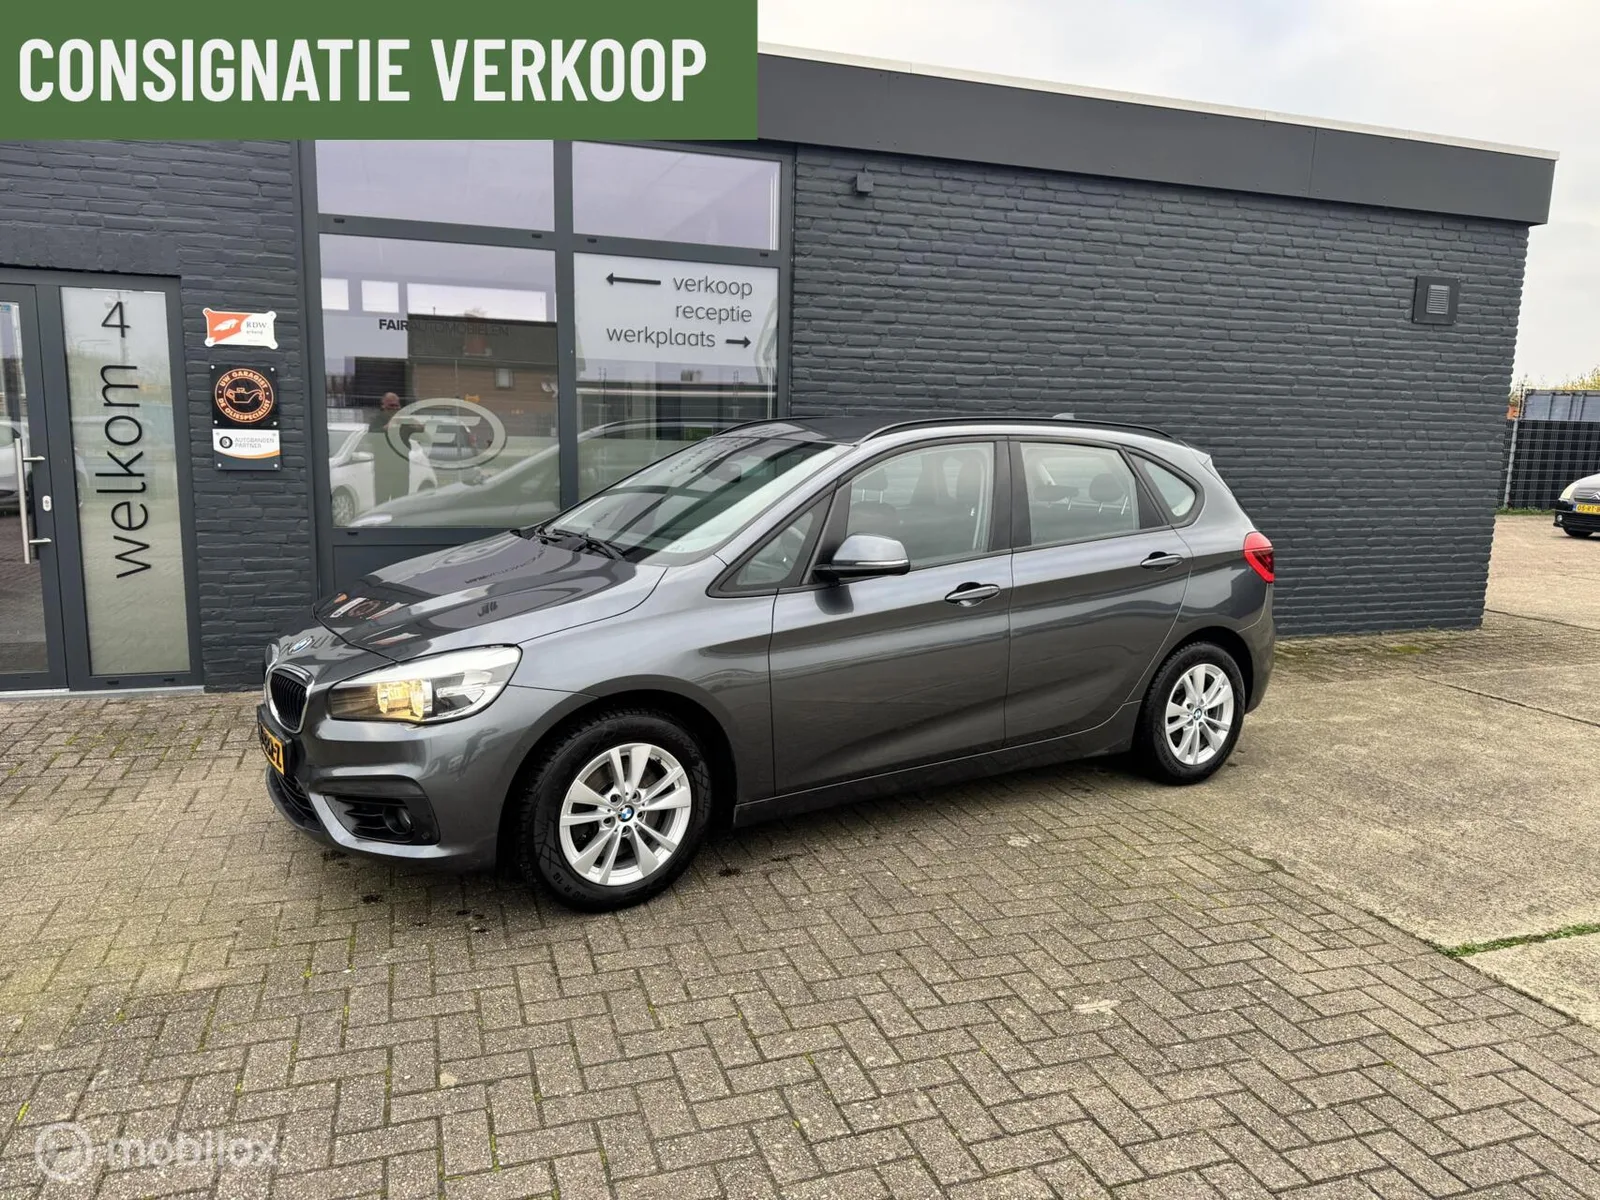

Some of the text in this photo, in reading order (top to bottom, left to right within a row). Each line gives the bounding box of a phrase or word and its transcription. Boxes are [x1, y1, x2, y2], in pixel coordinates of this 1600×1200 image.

[673, 275, 753, 299] verkoop
[675, 305, 752, 324] receptie
[606, 326, 716, 348] werkplaats
[95, 301, 152, 578] welkom 4
